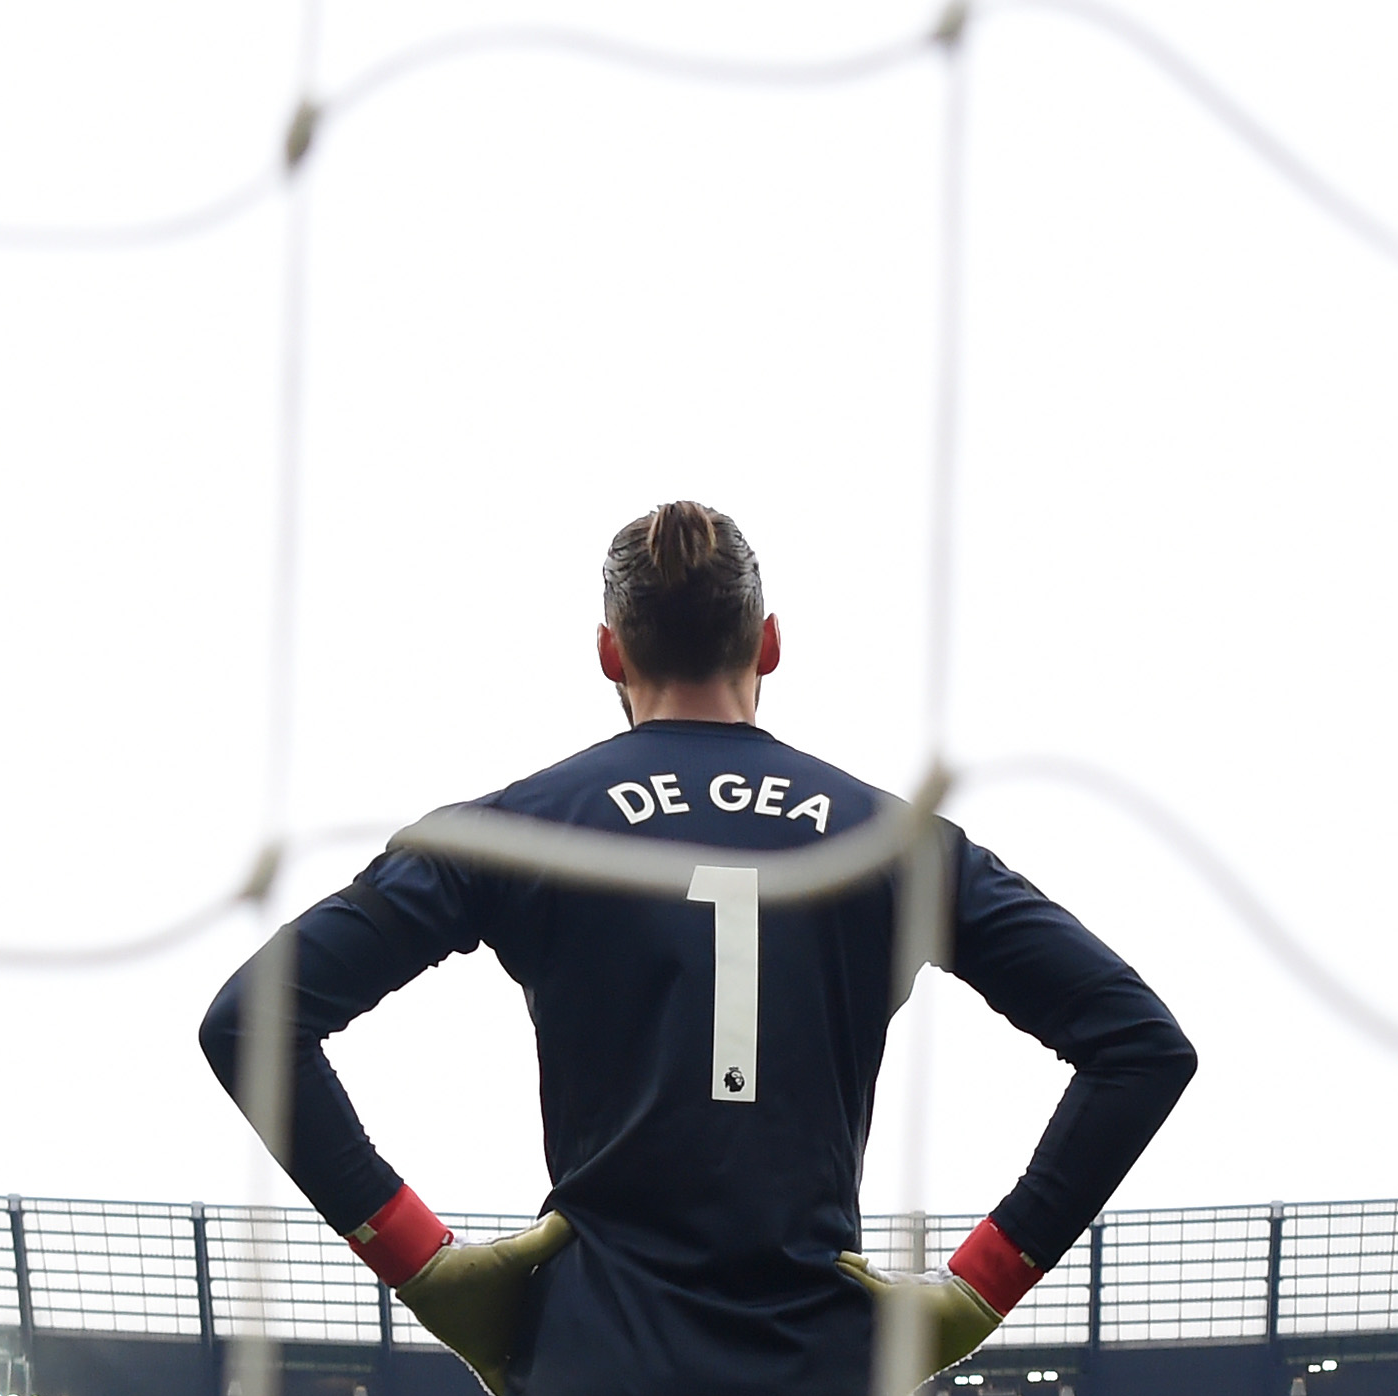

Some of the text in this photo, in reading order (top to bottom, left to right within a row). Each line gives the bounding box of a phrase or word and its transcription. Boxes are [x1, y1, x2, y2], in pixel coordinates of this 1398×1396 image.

[607, 773, 831, 834] DE GEA
[686, 864, 759, 1102] 1
